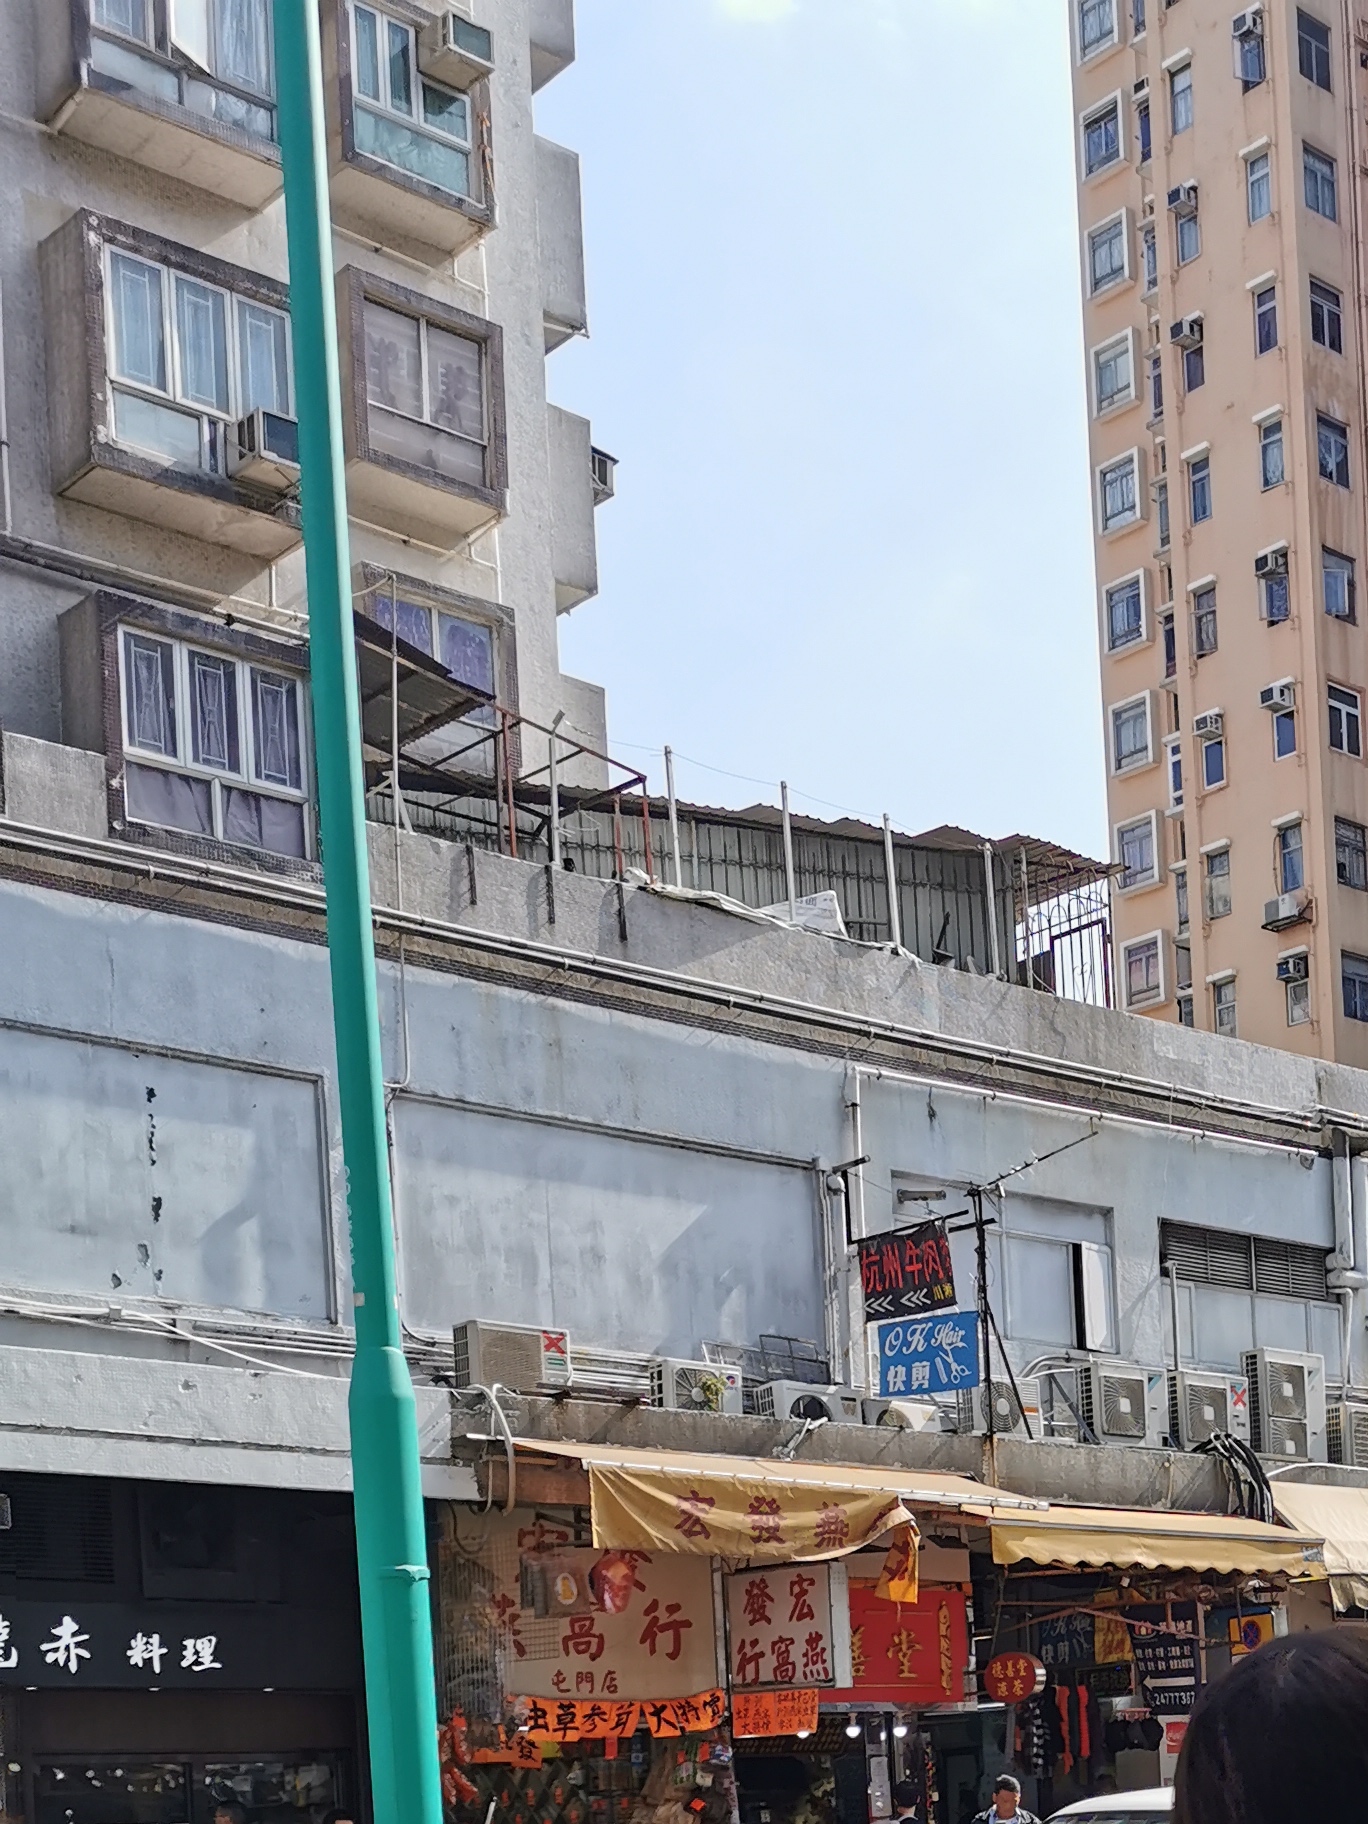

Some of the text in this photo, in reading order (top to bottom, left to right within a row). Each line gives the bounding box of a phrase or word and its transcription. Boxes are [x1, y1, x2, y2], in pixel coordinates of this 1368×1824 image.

[931, 1321, 969, 1349] Hair
[887, 1360, 931, 1393] 快剪
[551, 1669, 619, 1695] 屯門店
